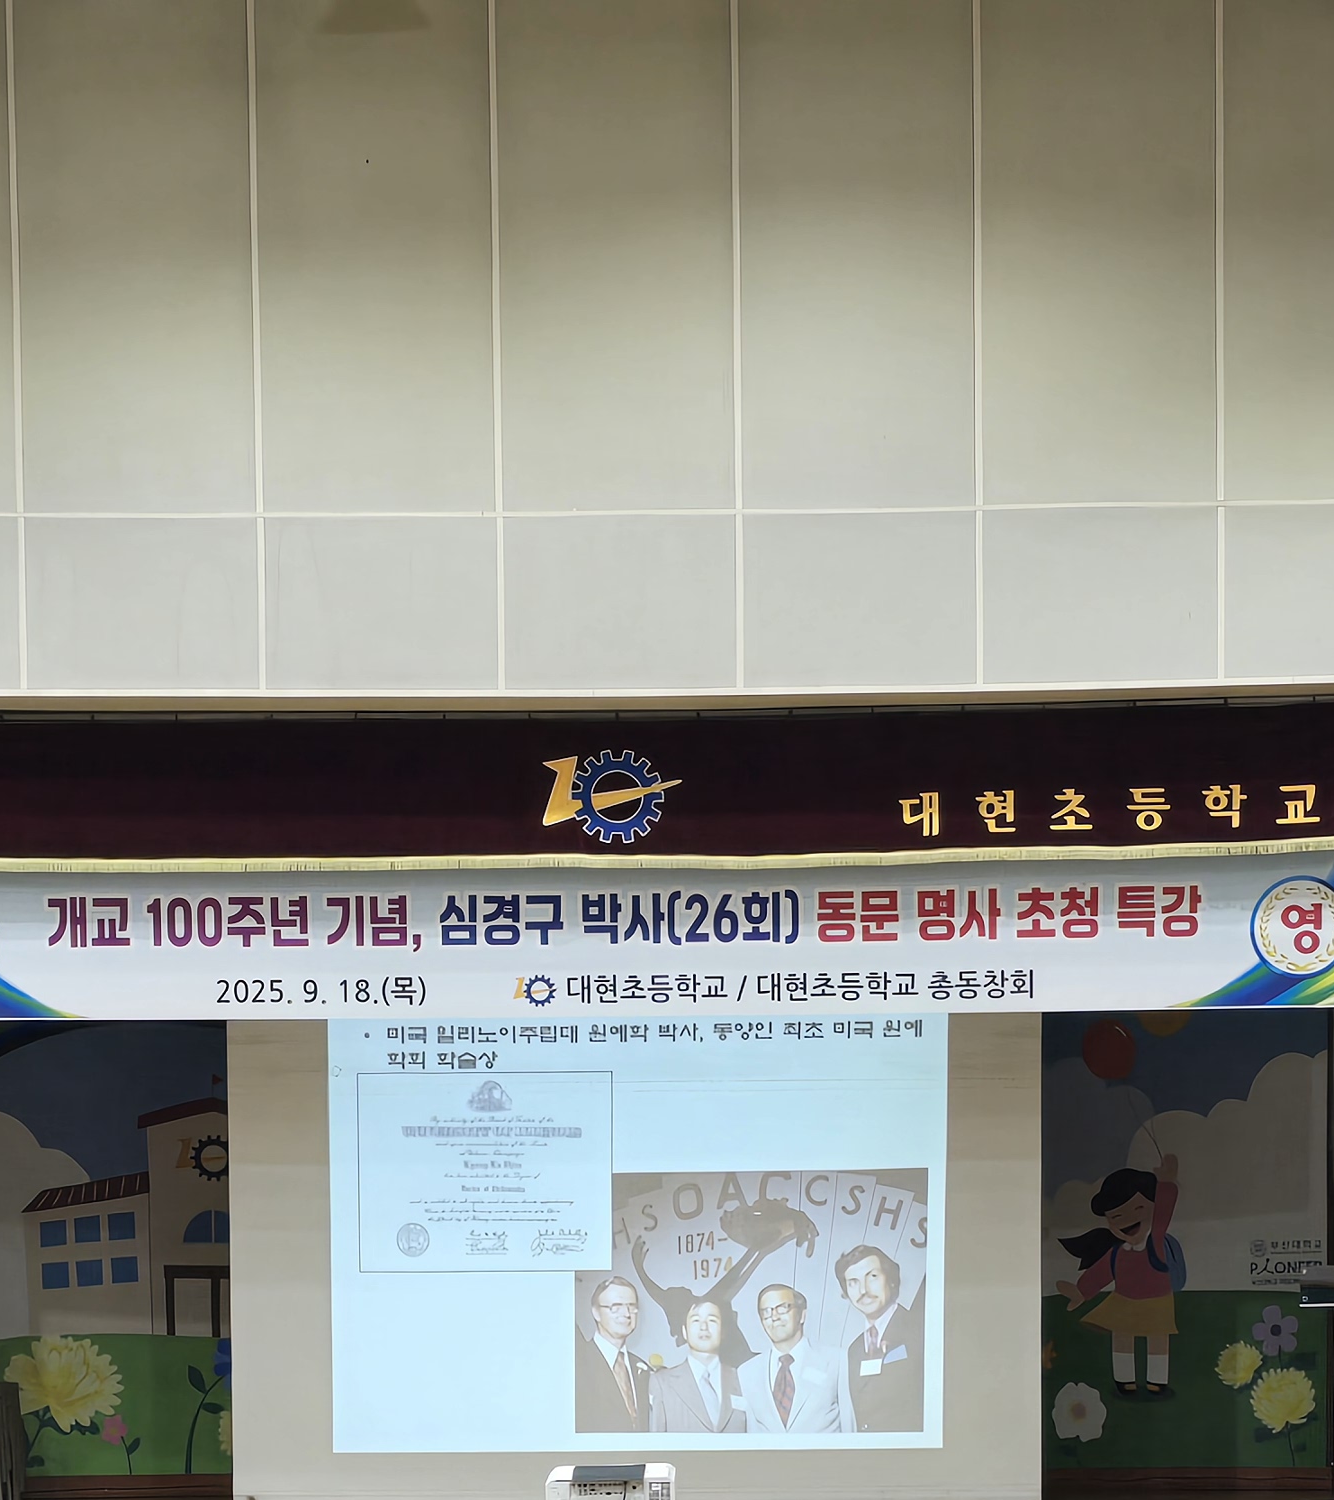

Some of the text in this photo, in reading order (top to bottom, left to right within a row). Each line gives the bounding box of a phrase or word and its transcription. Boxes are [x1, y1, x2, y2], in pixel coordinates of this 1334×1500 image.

[899, 783, 1323, 838] 대현초등학교
[46, 884, 1203, 953] 개교 100주년 기념, 심경구 박사(26회) 동문 명사 초청 특강
[1280, 902, 1324, 954] 영
[216, 975, 427, 1007] 2025. 9. 18.(목)
[566, 969, 1035, 1005] 대현초등학교 / 대현초등학교 총동창회
[386, 1018, 924, 1045] 미국 일리노이주립대 원예학 박사, 동양인 최초 미국 원예
[386, 1050, 499, 1070] 학회 학술상
